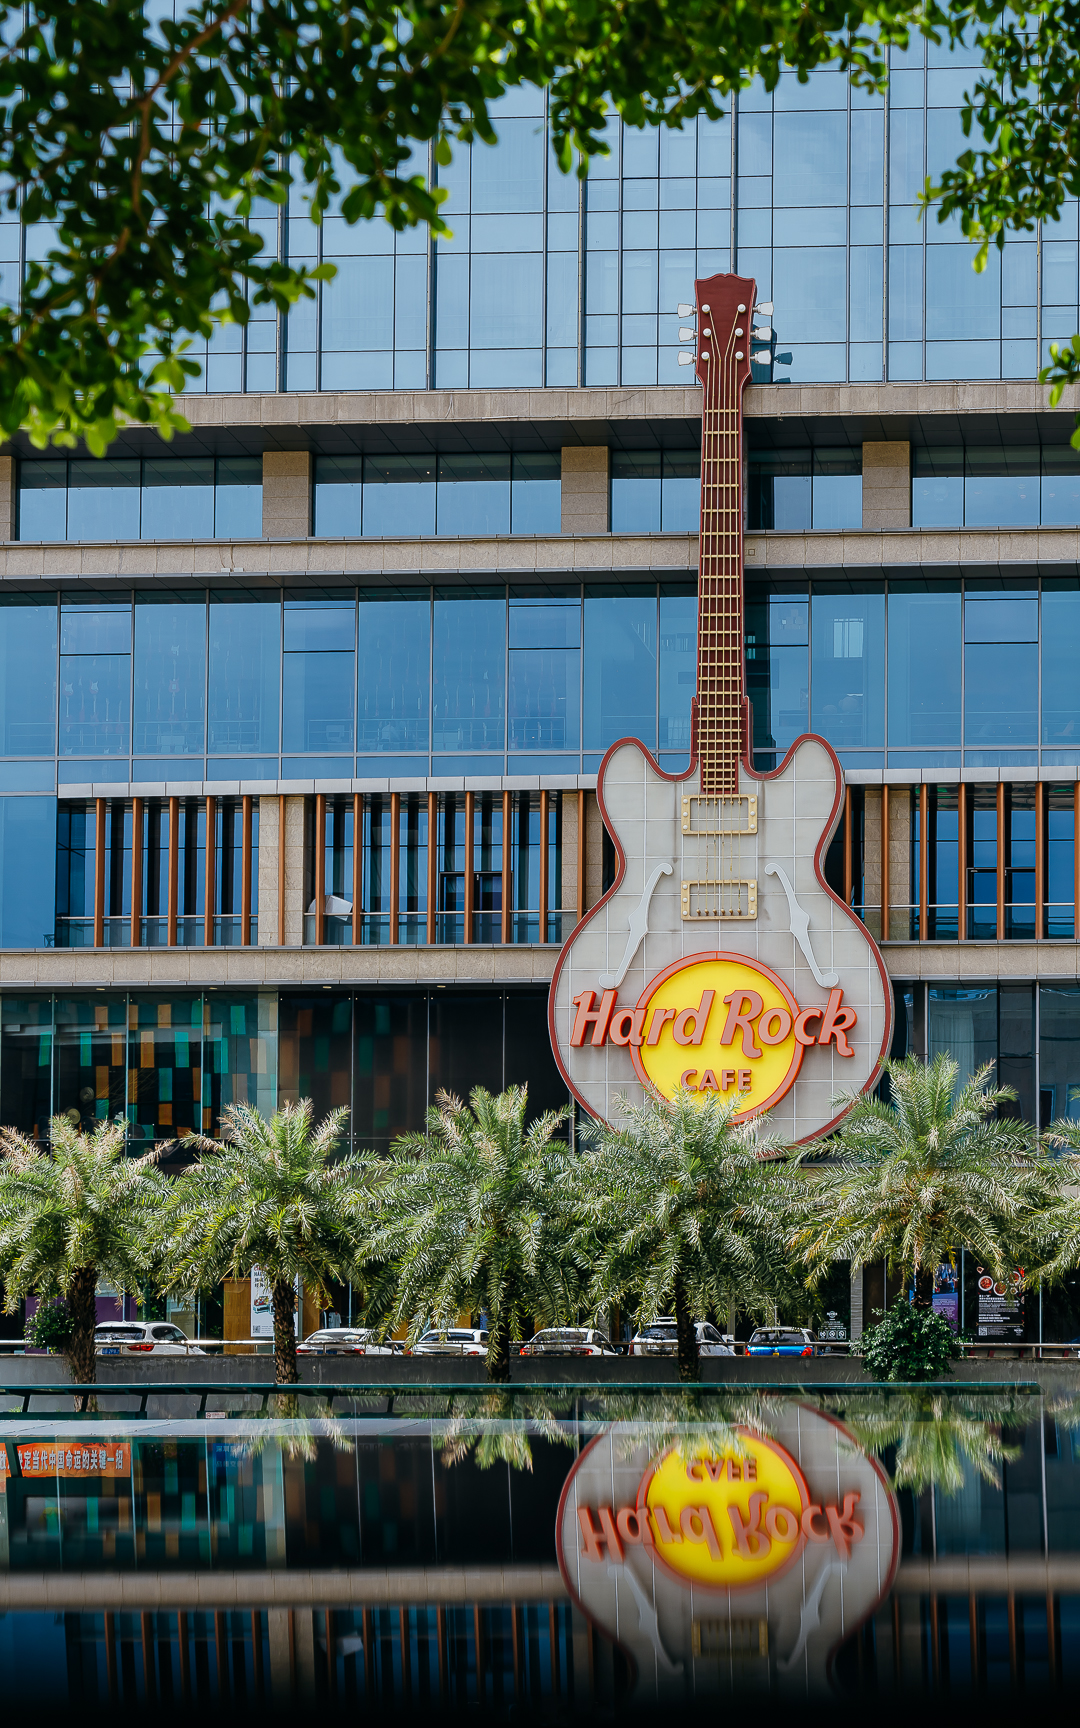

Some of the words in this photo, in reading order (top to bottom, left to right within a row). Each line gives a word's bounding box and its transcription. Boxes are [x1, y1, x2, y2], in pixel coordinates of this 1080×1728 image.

[570, 990, 715, 1046] Hard
[720, 989, 857, 1058] Rock
[680, 1069, 752, 1091] CAFE
